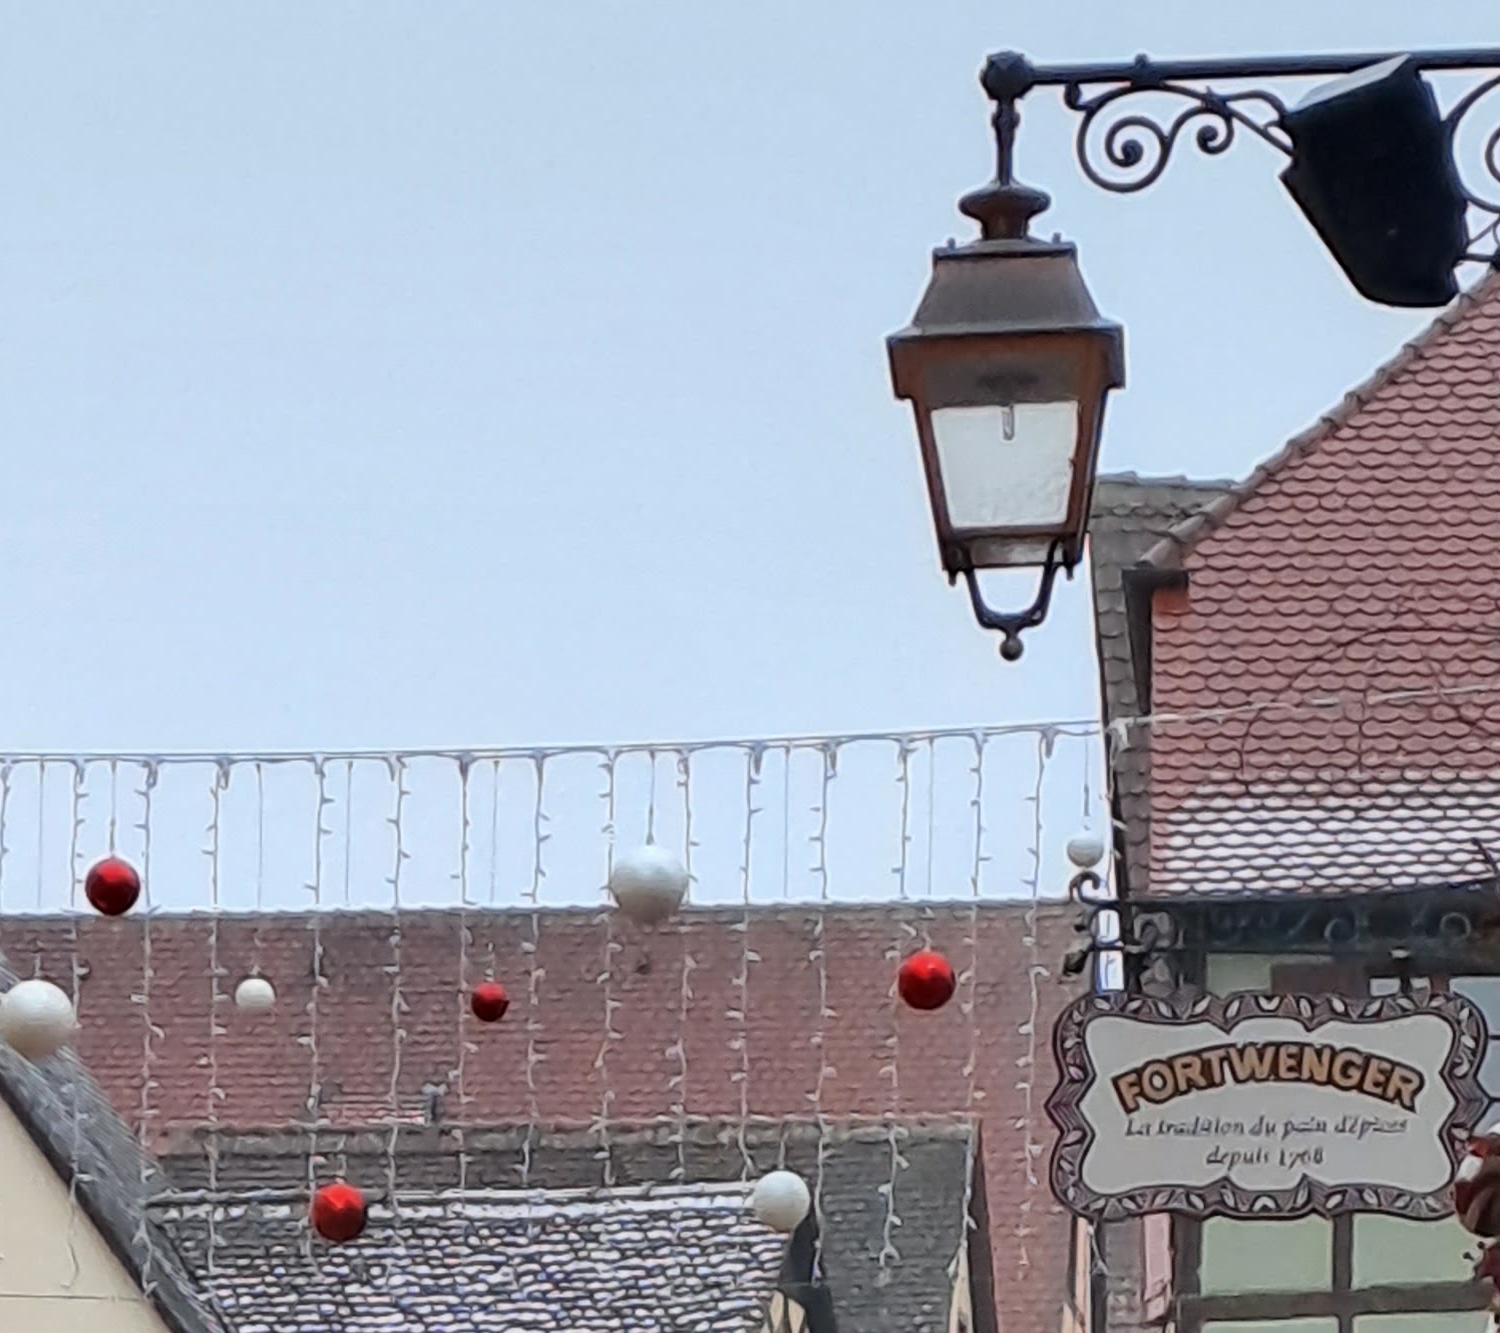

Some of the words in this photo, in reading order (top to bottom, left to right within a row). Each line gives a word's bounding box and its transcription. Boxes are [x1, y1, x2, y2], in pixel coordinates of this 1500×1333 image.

[1112, 1042, 1425, 1113] FORTWENGER
[1125, 1118, 1151, 1136] La
[1250, 1114, 1276, 1136] du
